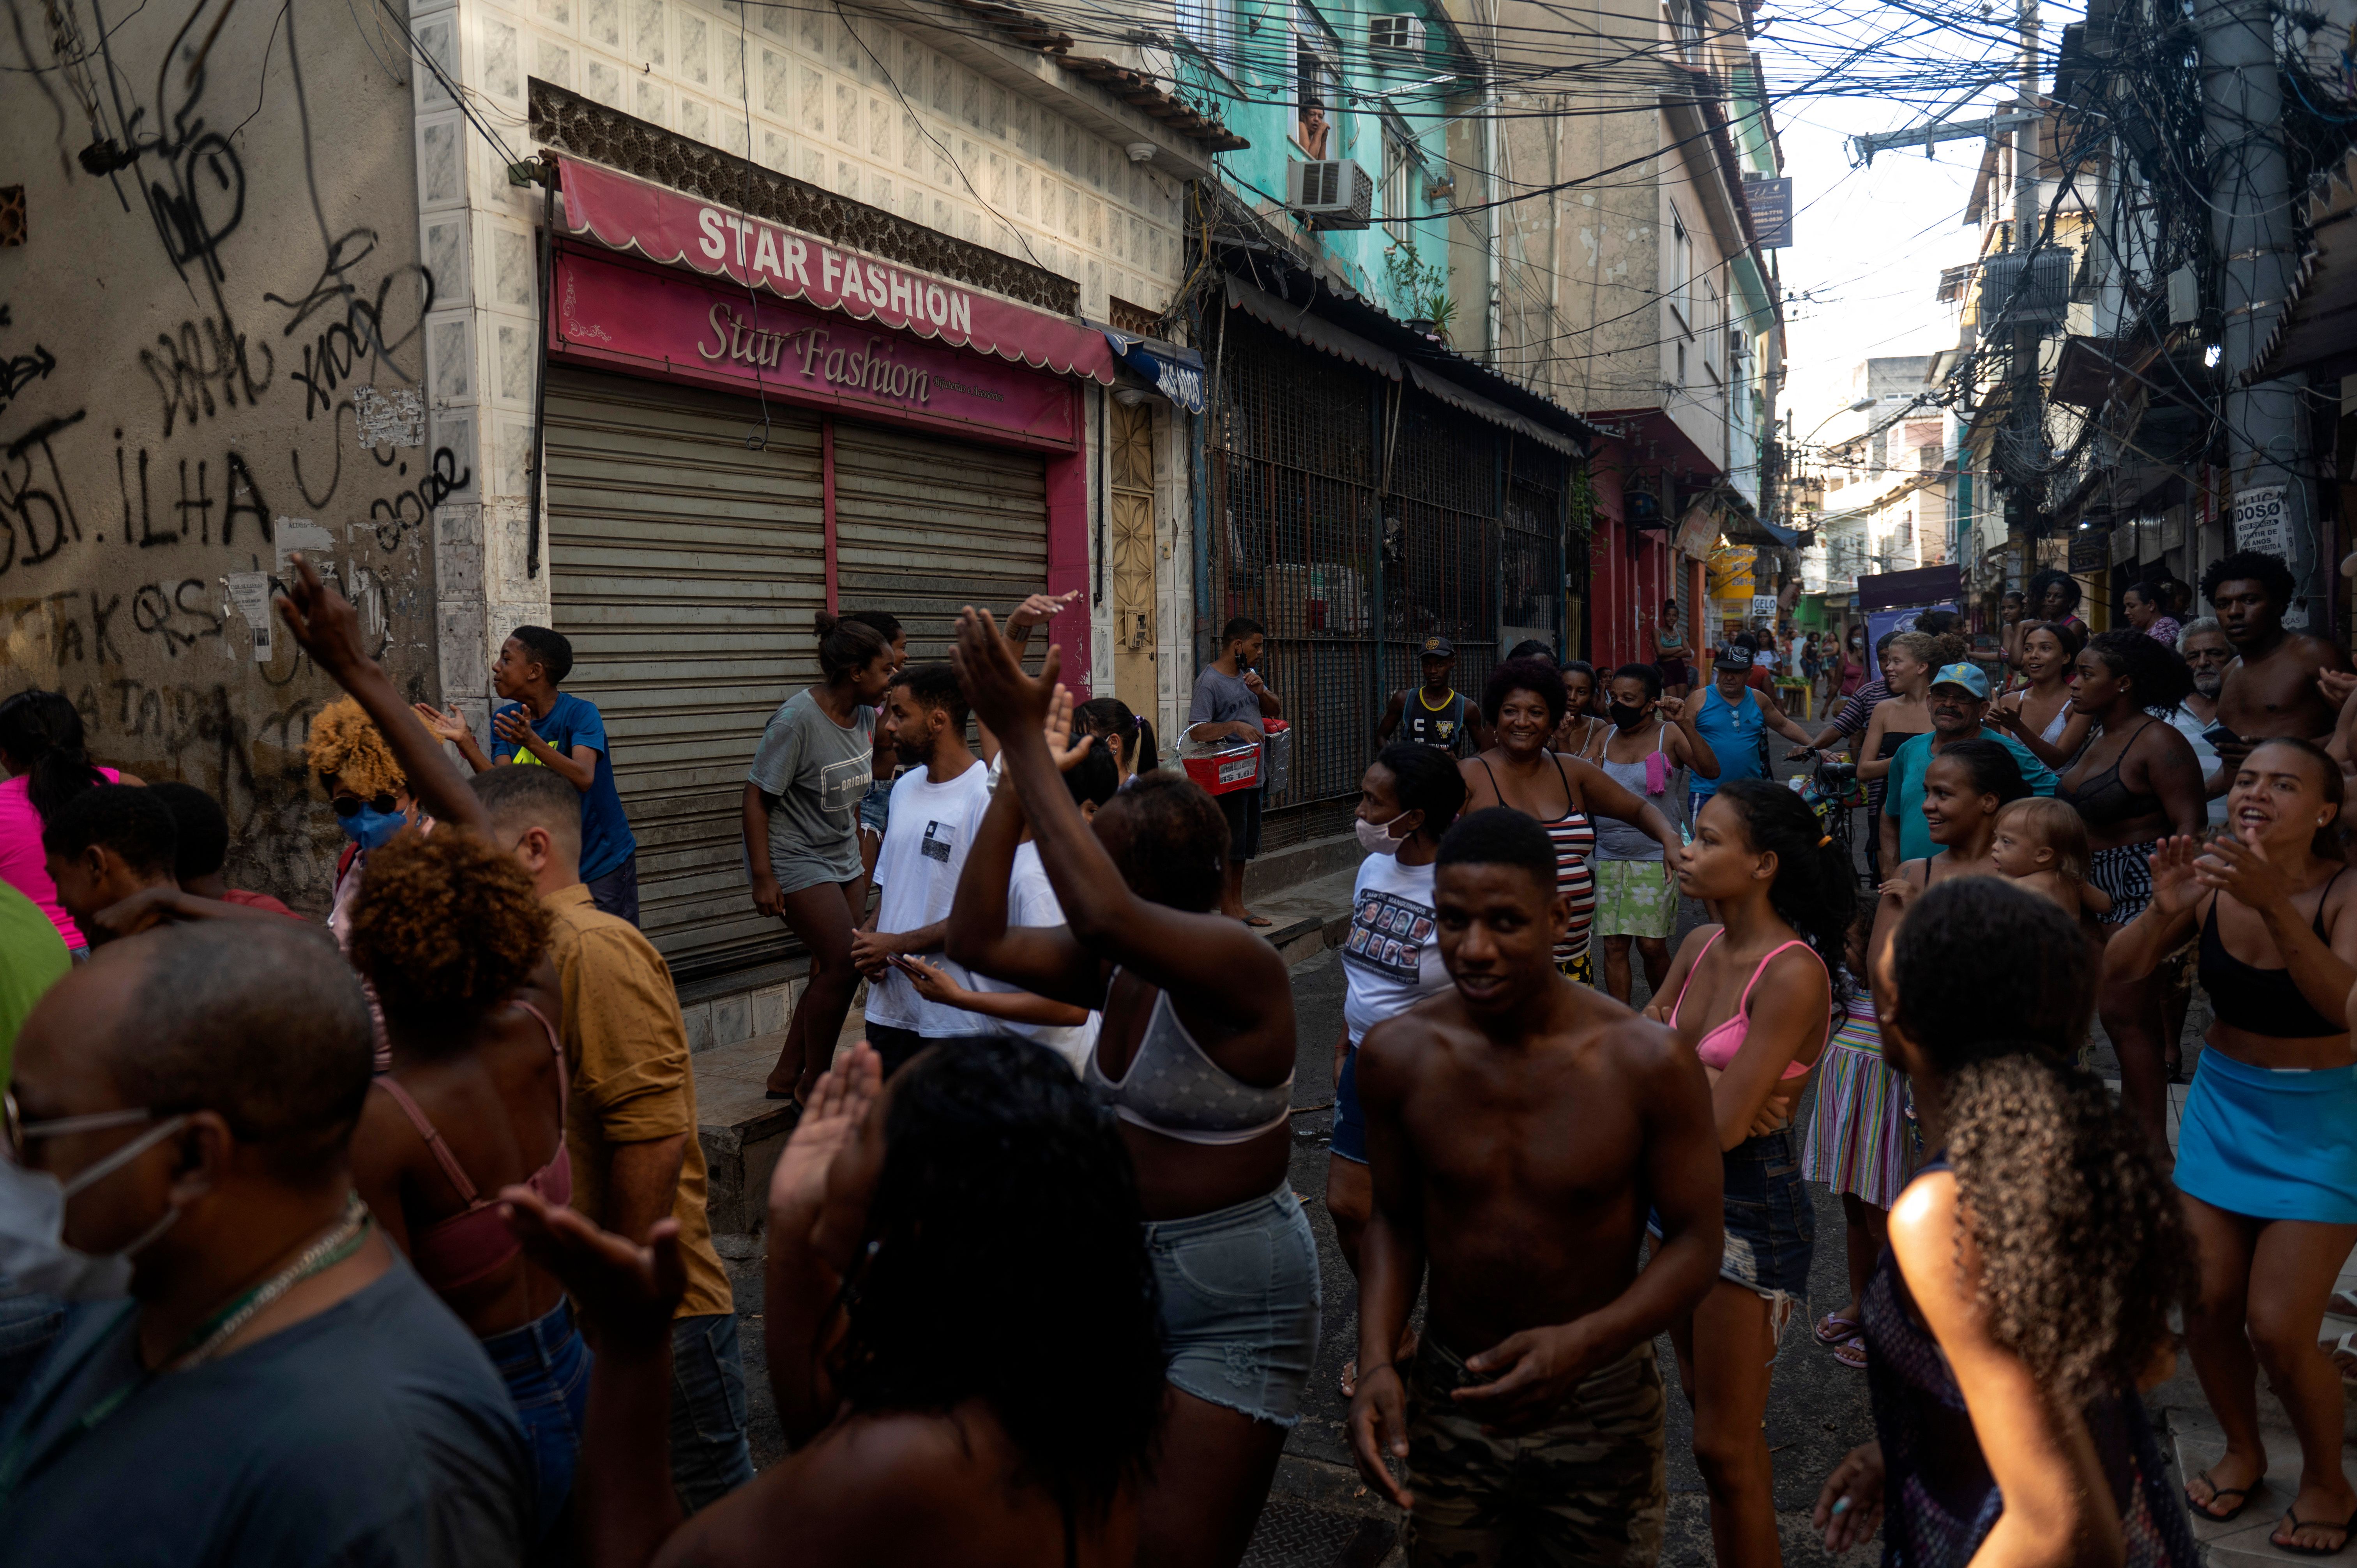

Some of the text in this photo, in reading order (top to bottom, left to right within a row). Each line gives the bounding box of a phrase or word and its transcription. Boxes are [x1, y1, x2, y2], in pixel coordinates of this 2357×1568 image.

[698, 207, 971, 334] STAR FASHION
[698, 302, 930, 402] Star Fashion
[934, 376, 966, 391] Bijuterias
[971, 385, 1004, 402] Acessórios
[2252, 519, 2276, 528] RENDA
[2244, 531, 2265, 540] PARTIR
[2257, 543, 2276, 553] DIREITO
[1754, 599, 1776, 609] GELO
